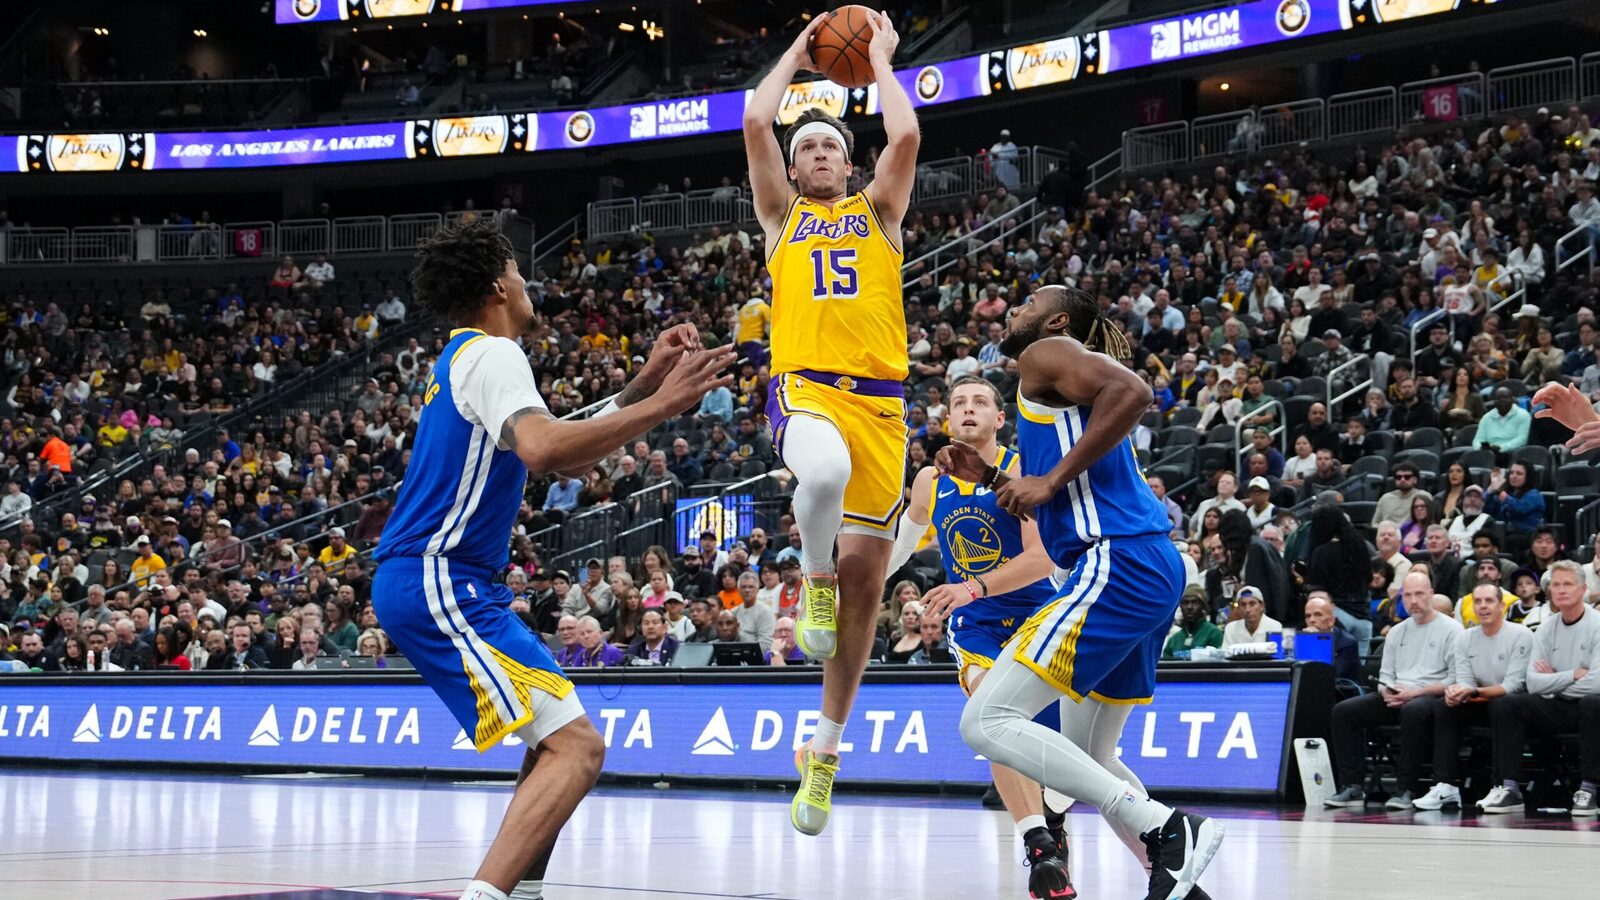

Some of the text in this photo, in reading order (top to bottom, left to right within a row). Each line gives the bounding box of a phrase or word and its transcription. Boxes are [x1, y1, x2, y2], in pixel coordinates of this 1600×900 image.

[1183, 9, 1239, 41] MGM
[1183, 33, 1240, 54] REWARDS
[658, 99, 709, 123] MGM
[1431, 93, 1452, 116] 16
[658, 119, 709, 135] REWARDS
[170, 134, 396, 157] LOS ANGELES LAKERS
[788, 211, 870, 243] LAKERS
[241, 234, 256, 251] 18
[810, 248, 858, 300] 15
[941, 506, 996, 529] GOLDEN STATE
[979, 527, 991, 543] 2
[0, 705, 420, 744] LTA DELTA DELTA
[1115, 711, 1258, 759] LTA
